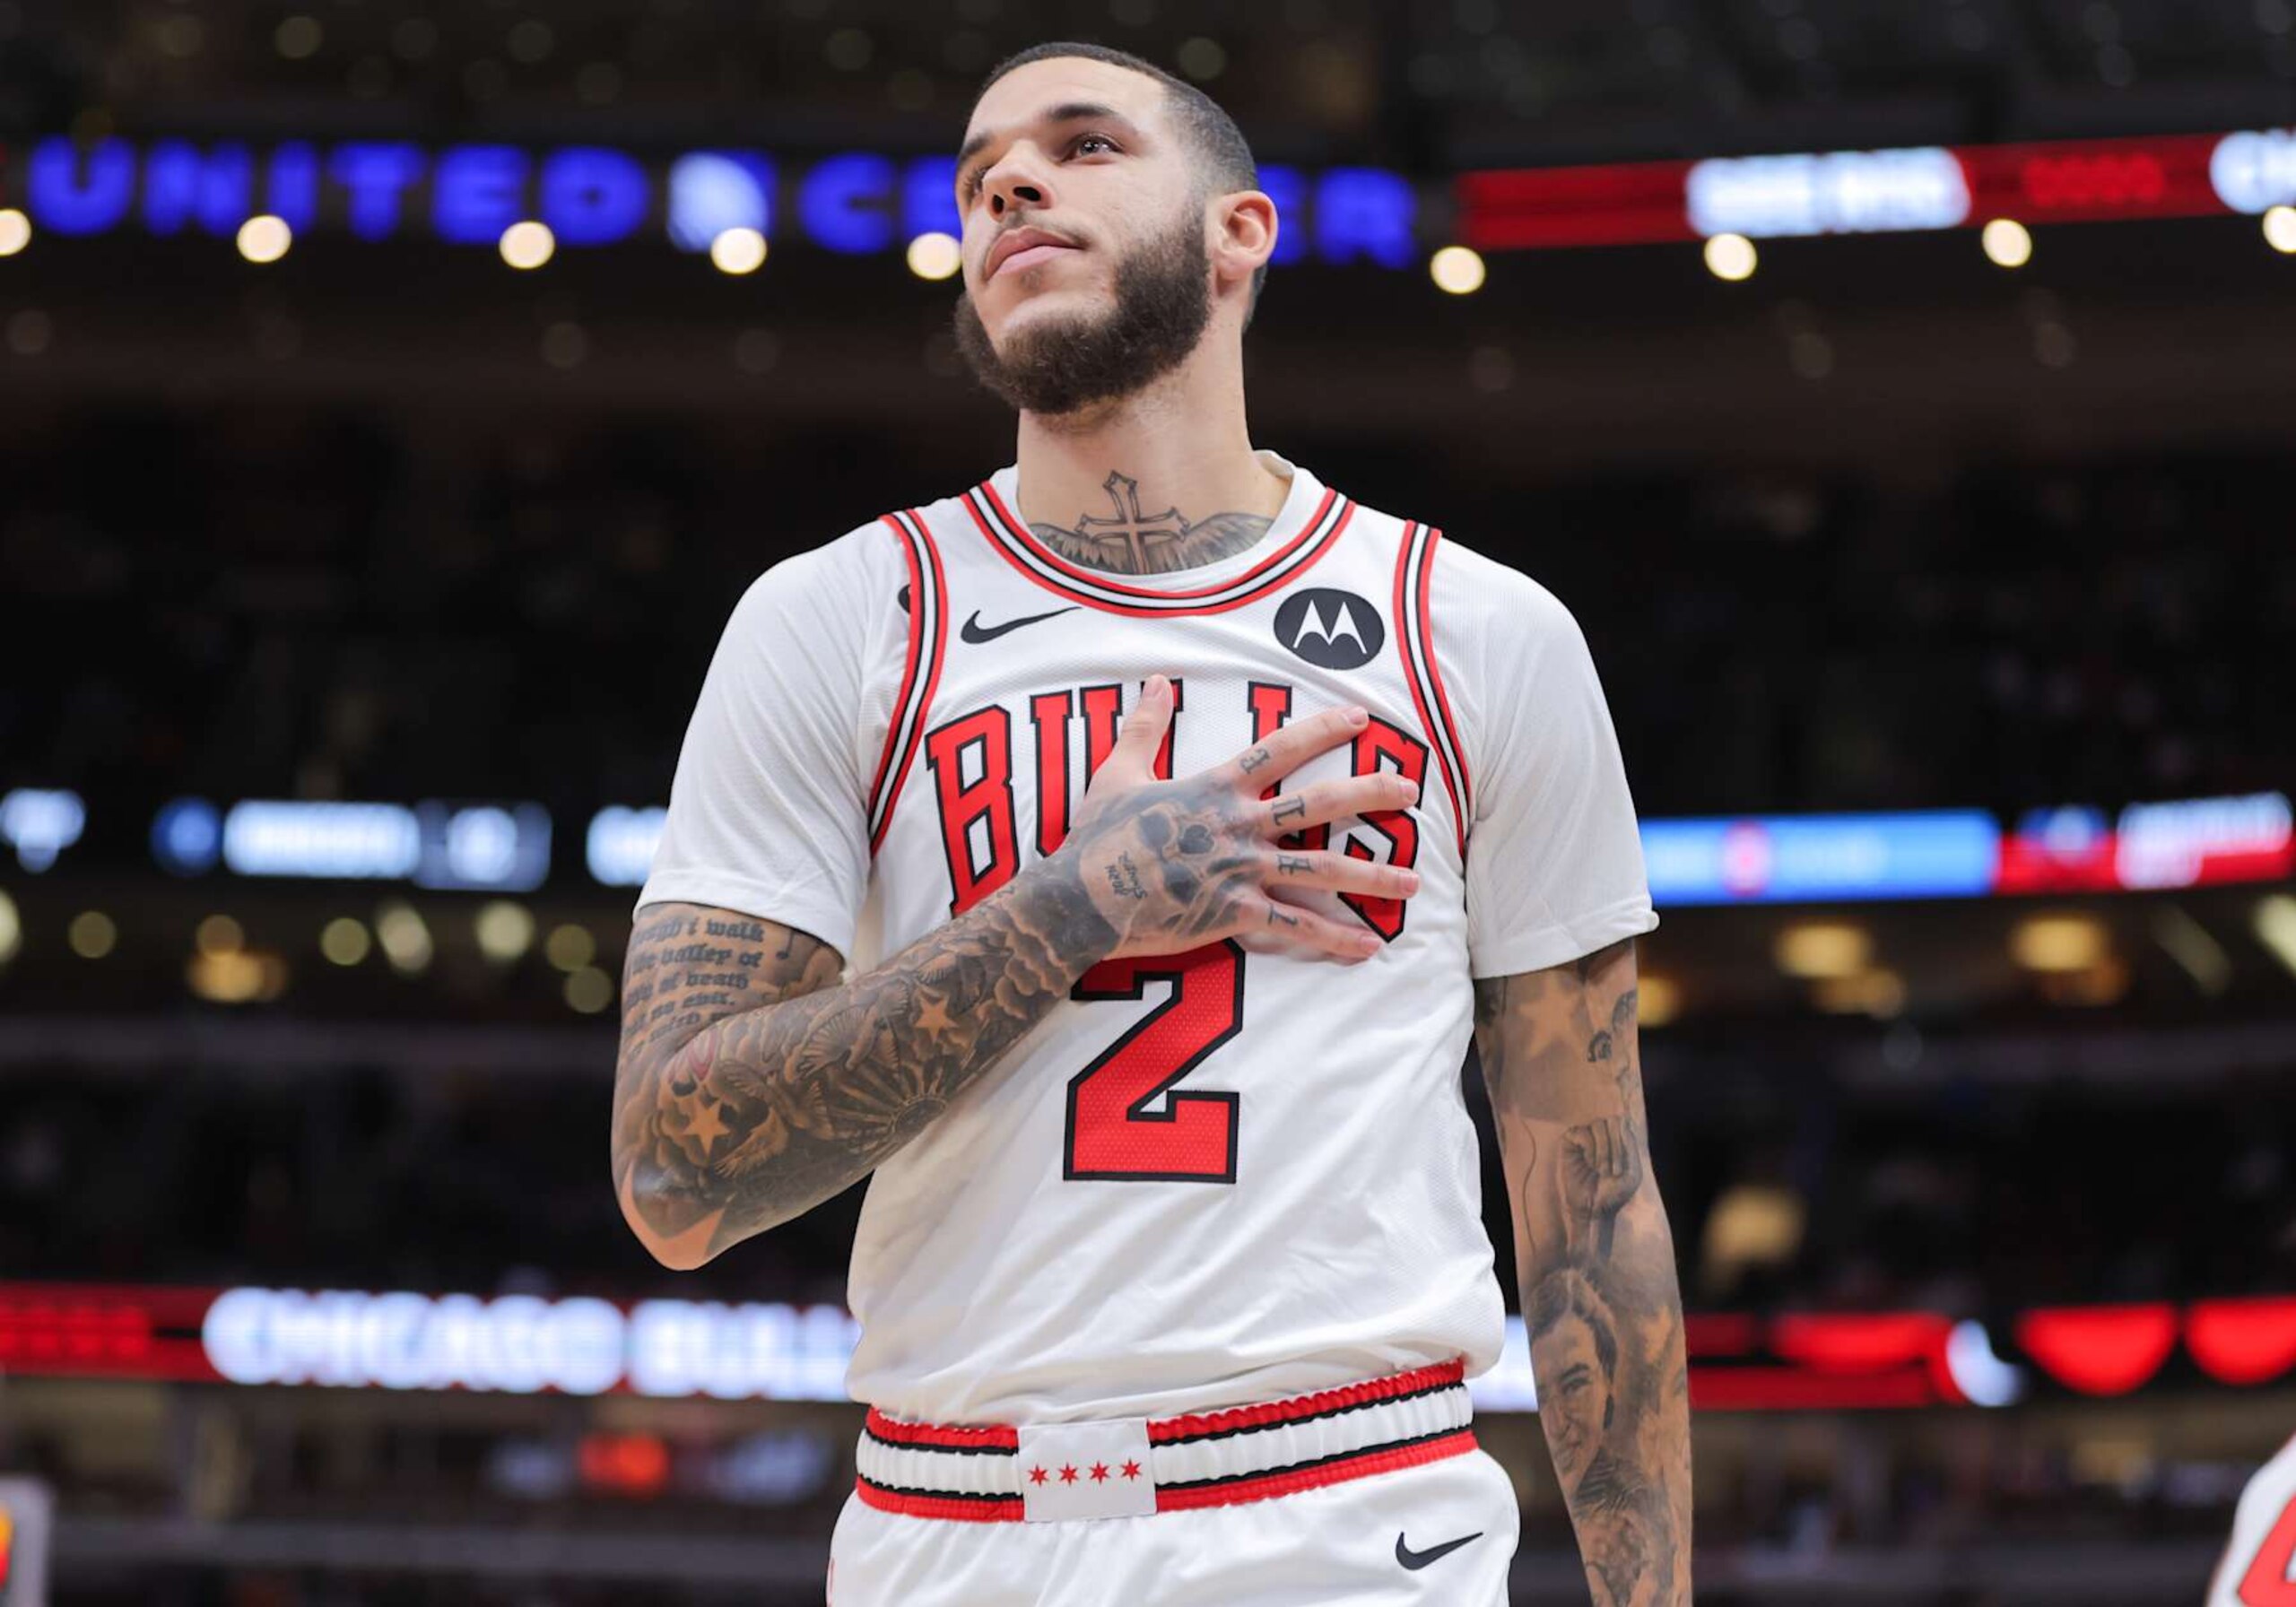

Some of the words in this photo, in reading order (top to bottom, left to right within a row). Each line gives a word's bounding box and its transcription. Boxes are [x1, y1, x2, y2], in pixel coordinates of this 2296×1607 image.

[27, 136, 649, 246] UNITED
[796, 149, 1417, 269] CER
[1063, 936, 1246, 1184] 2
